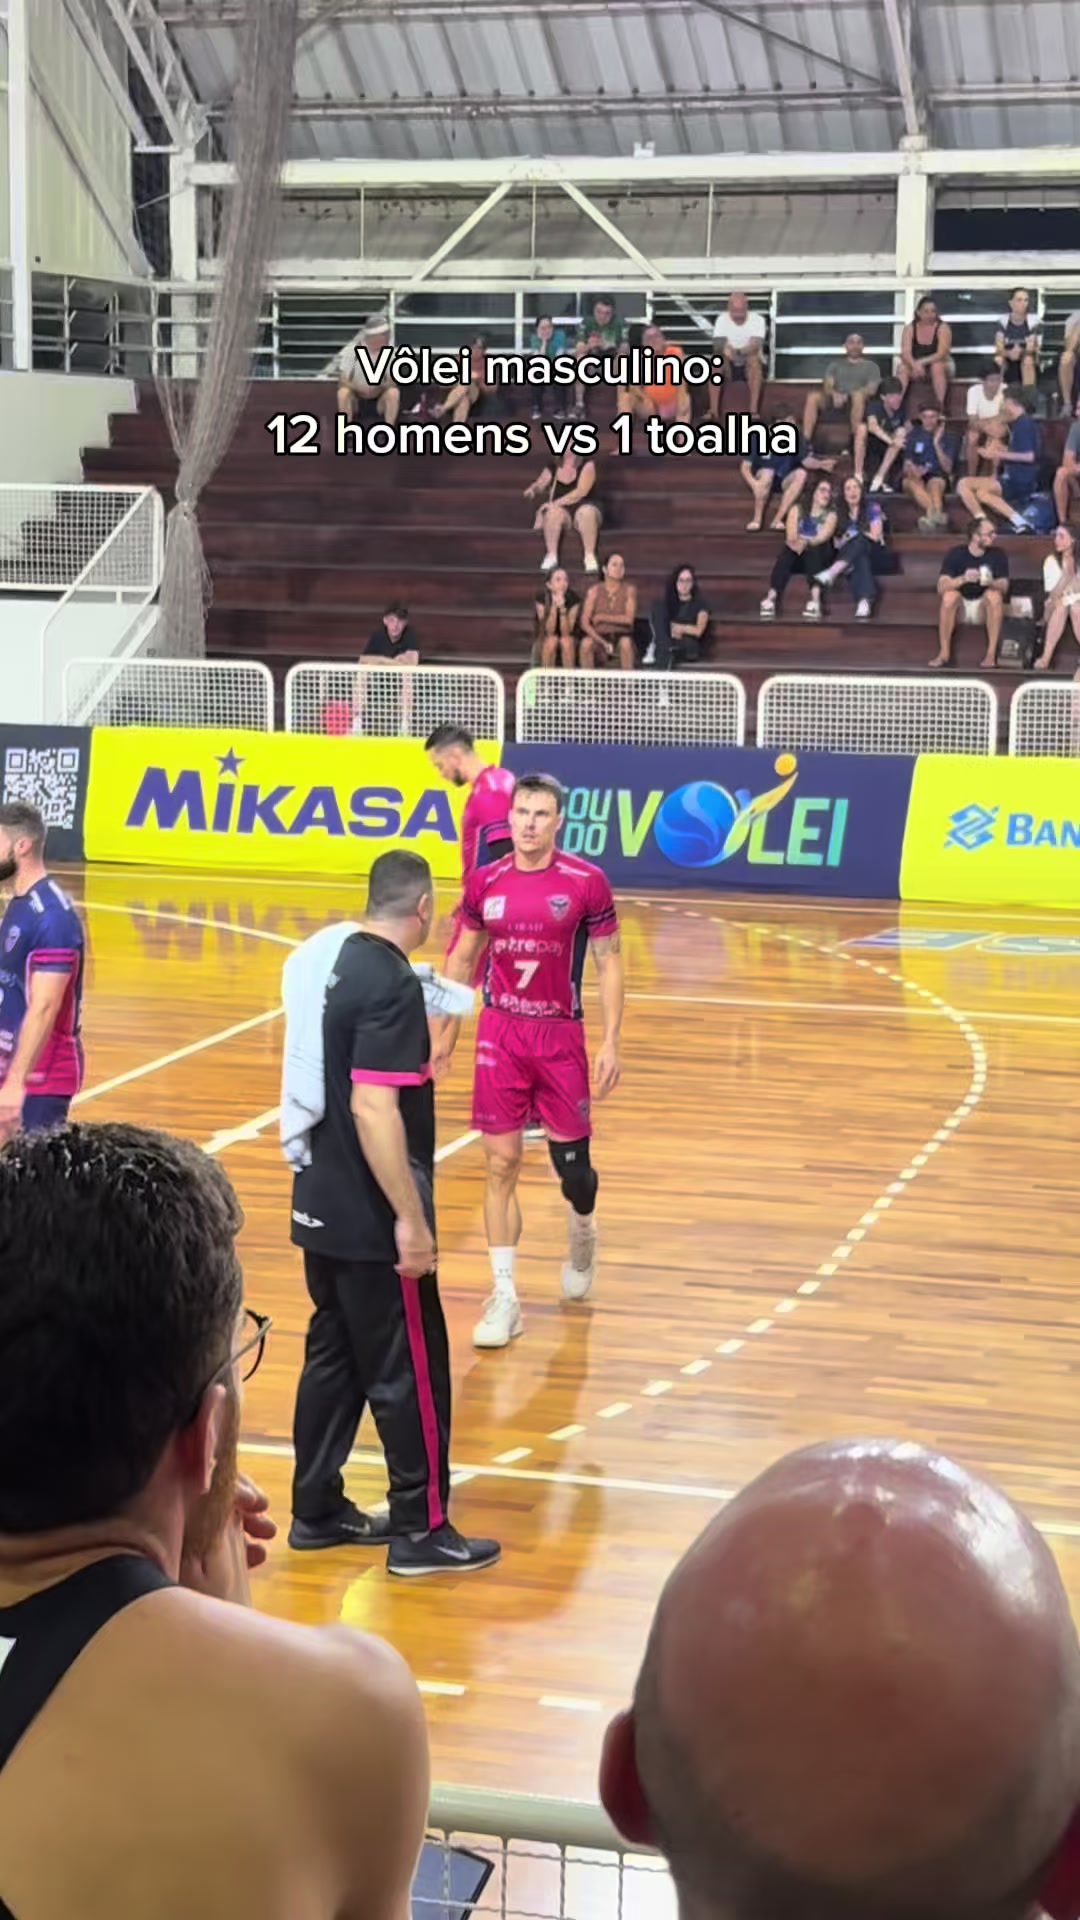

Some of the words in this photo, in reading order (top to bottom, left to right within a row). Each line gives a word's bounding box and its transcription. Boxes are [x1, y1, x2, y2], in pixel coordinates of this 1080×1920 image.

[124, 766, 459, 842] MIKASA
[563, 821, 608, 856] DO
[513, 959, 541, 990] 7
